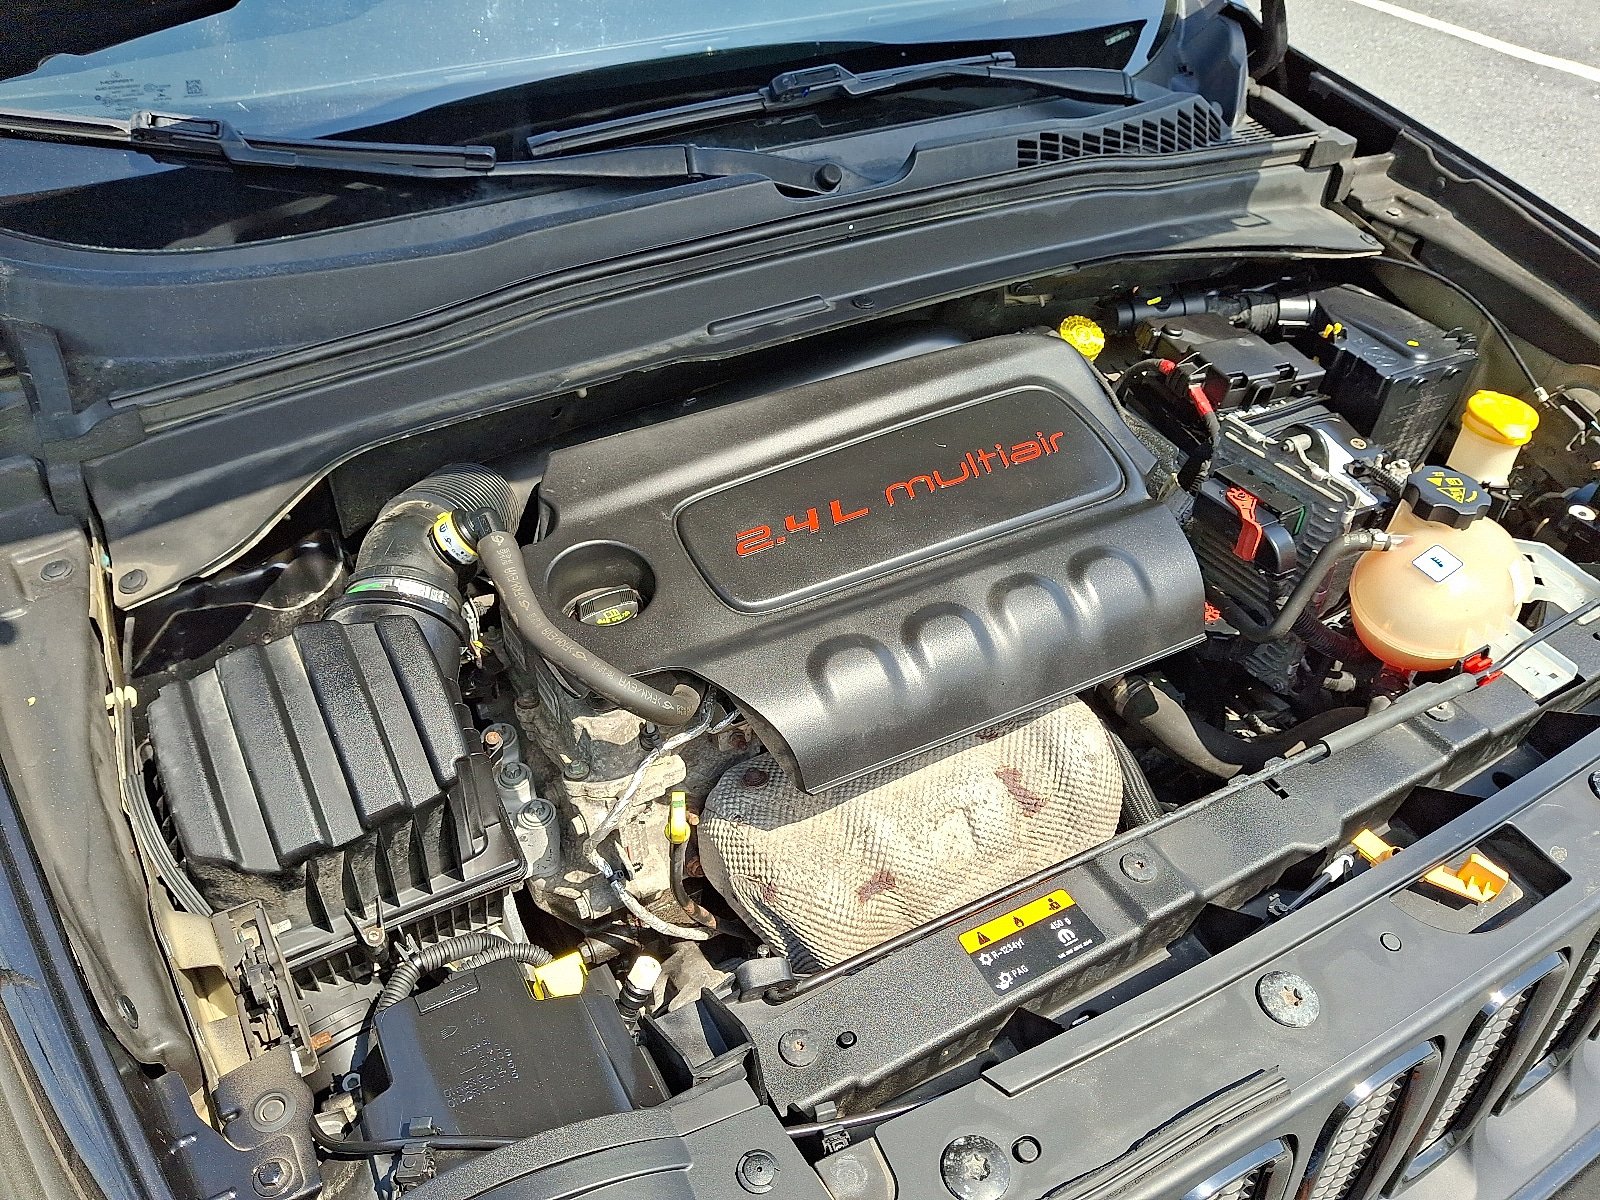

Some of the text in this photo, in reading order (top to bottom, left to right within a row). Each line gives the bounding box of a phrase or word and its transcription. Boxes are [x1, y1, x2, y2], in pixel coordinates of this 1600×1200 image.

[884, 430, 1065, 507] multiair
[1050, 919, 1064, 931] 450
[991, 937, 1026, 960] R-1234yf
[1011, 964, 1030, 979] PAG
